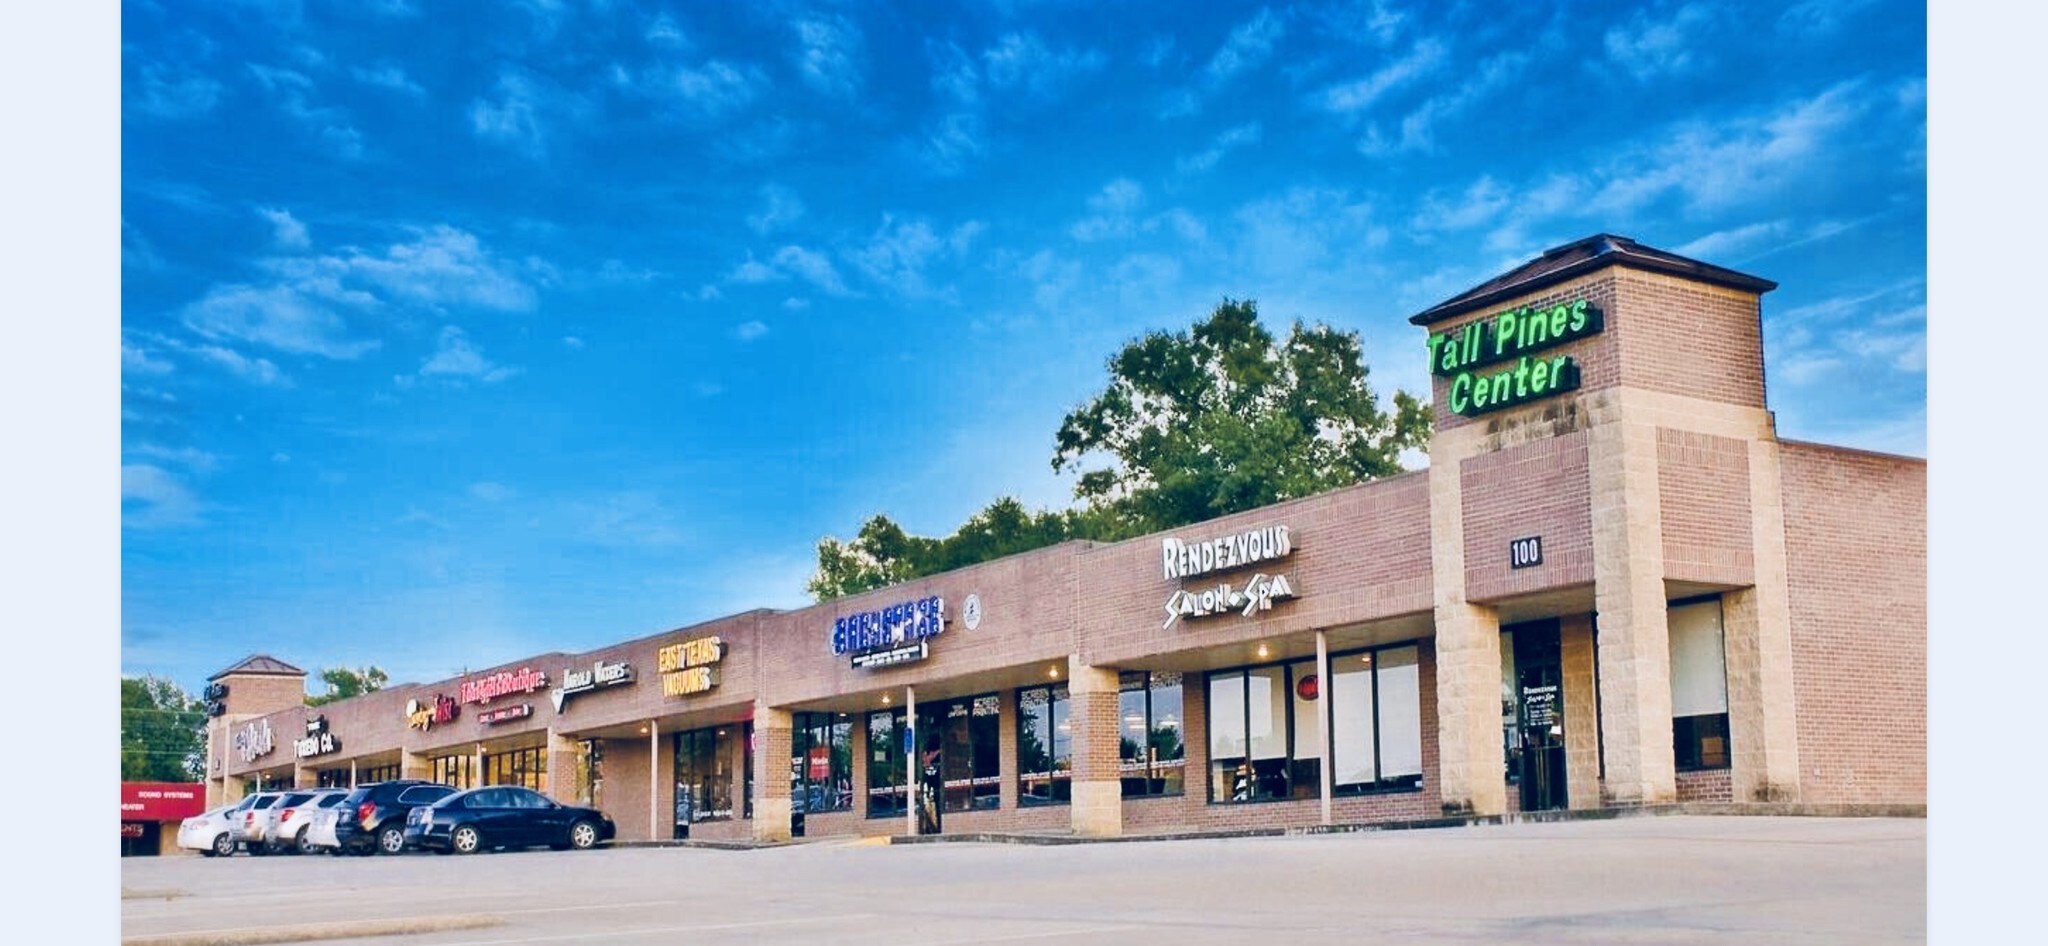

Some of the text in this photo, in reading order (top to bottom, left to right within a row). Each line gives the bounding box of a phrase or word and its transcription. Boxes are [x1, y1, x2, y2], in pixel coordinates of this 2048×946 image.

[1427, 299, 1588, 374] Tall Pines
[1449, 355, 1567, 414] Center
[1162, 525, 1291, 580] RENDEZVOUS
[1512, 539, 1538, 566] 100
[1162, 573, 1293, 630] SALON SPA
[658, 636, 721, 673] EAST TEXAS
[662, 667, 711, 697] VACUUMS
